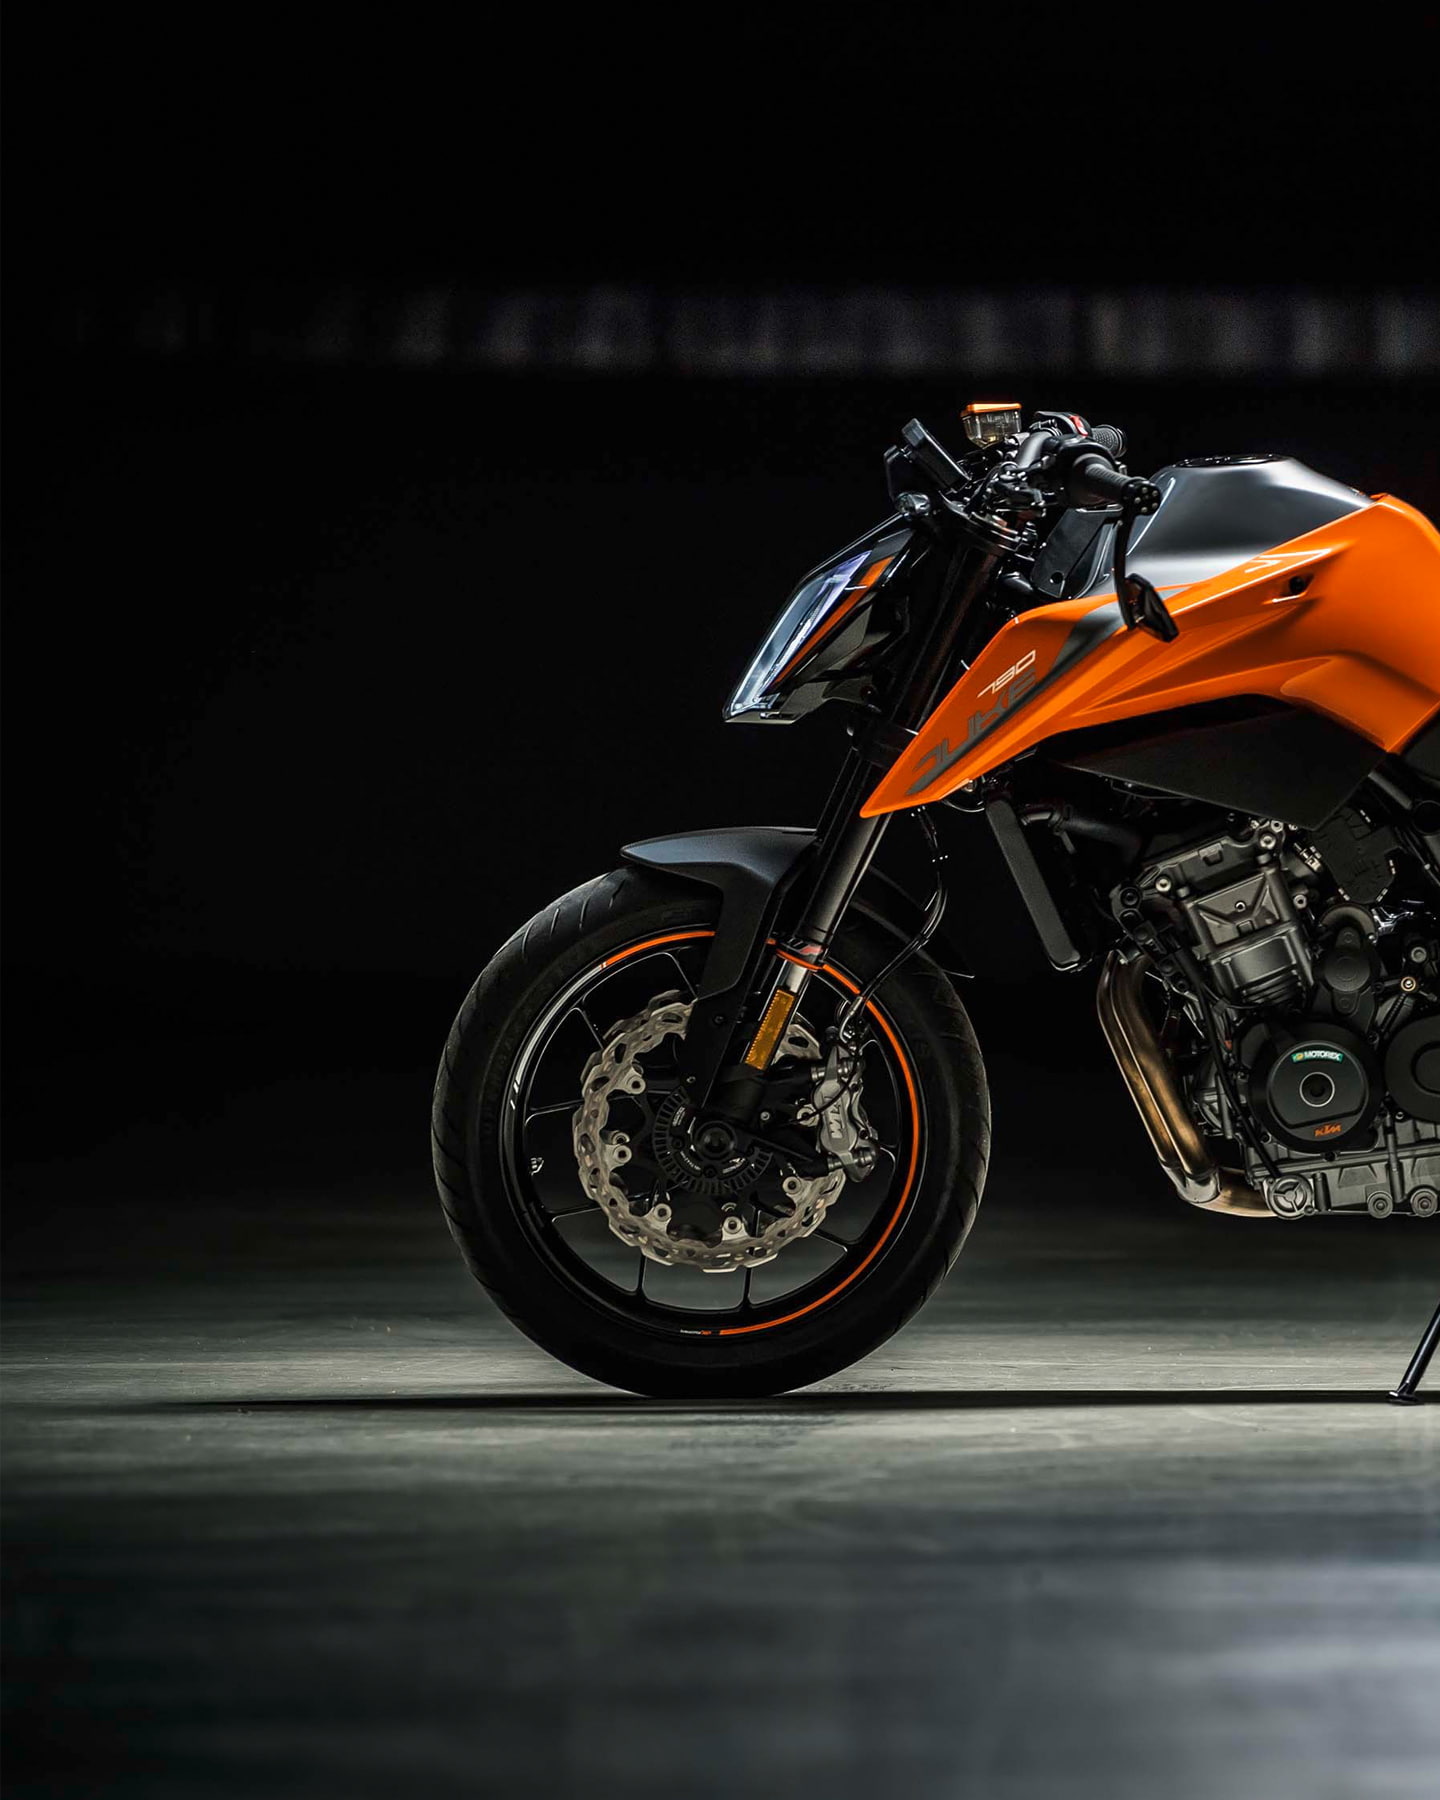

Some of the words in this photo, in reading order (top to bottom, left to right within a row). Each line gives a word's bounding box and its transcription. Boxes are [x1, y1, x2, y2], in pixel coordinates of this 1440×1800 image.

[977, 649, 1037, 698] 790
[912, 664, 1038, 774] DUKE
[1304, 1050, 1343, 1062] MOTOREX
[1314, 1122, 1342, 1137] KTM
